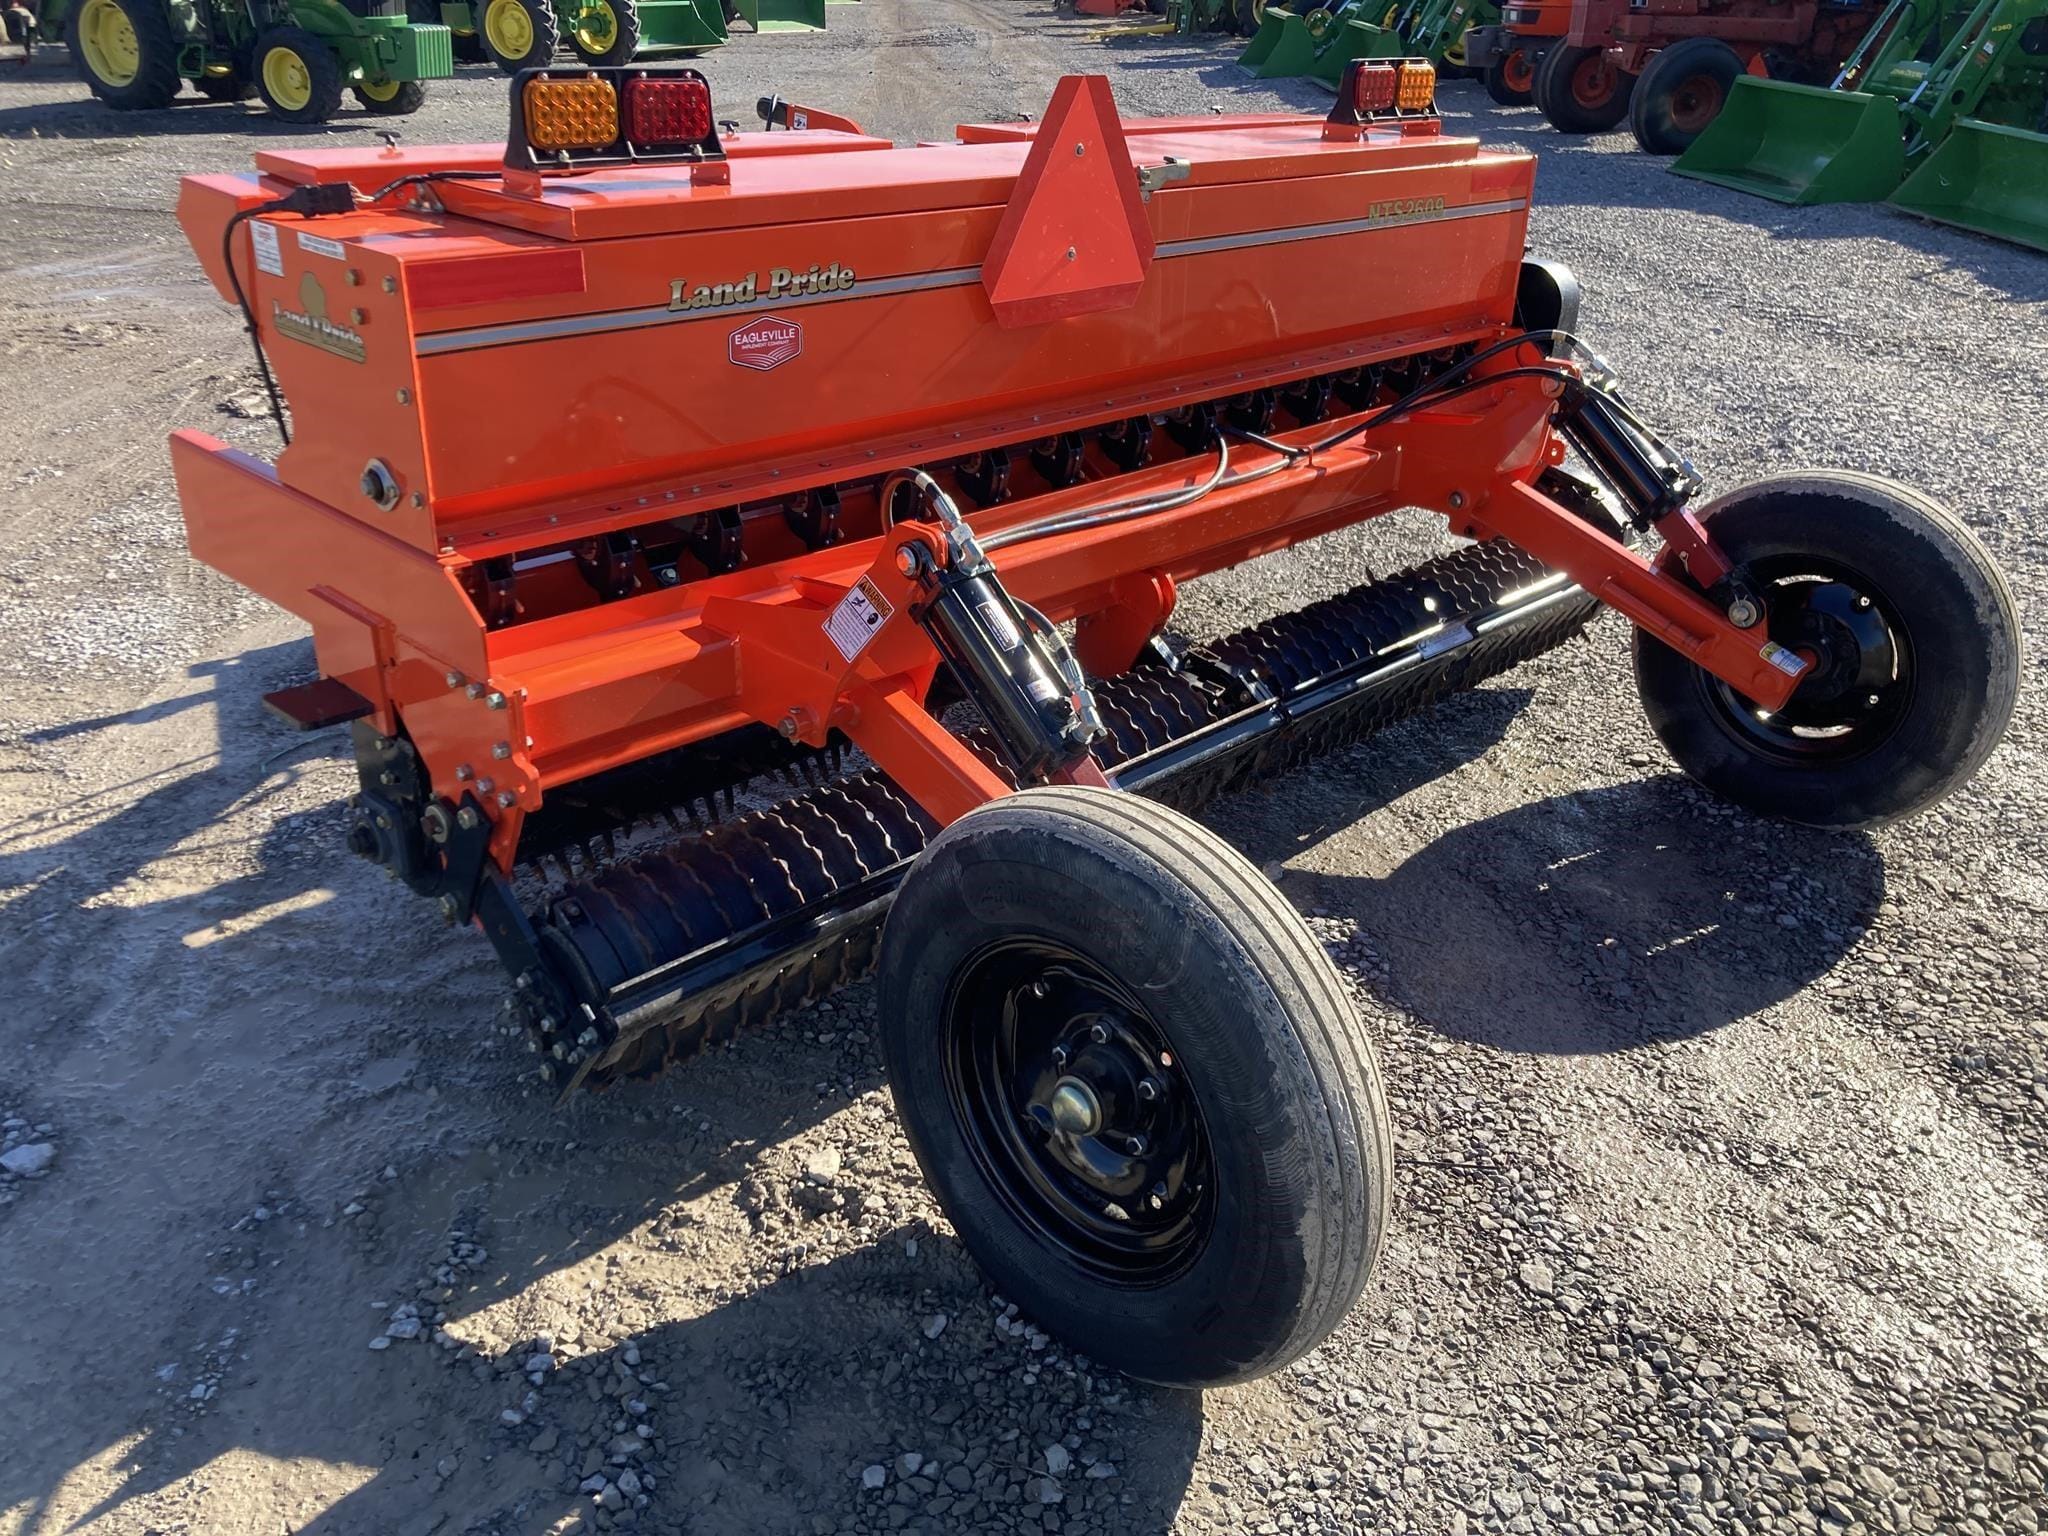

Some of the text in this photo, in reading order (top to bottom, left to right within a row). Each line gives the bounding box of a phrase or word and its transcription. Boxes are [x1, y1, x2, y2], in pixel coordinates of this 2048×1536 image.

[1368, 197, 1444, 224] NTS2609
[667, 263, 855, 312] Land Pride
[735, 328, 796, 345] EAGLEVILLE
[864, 581, 890, 617] WARNING
